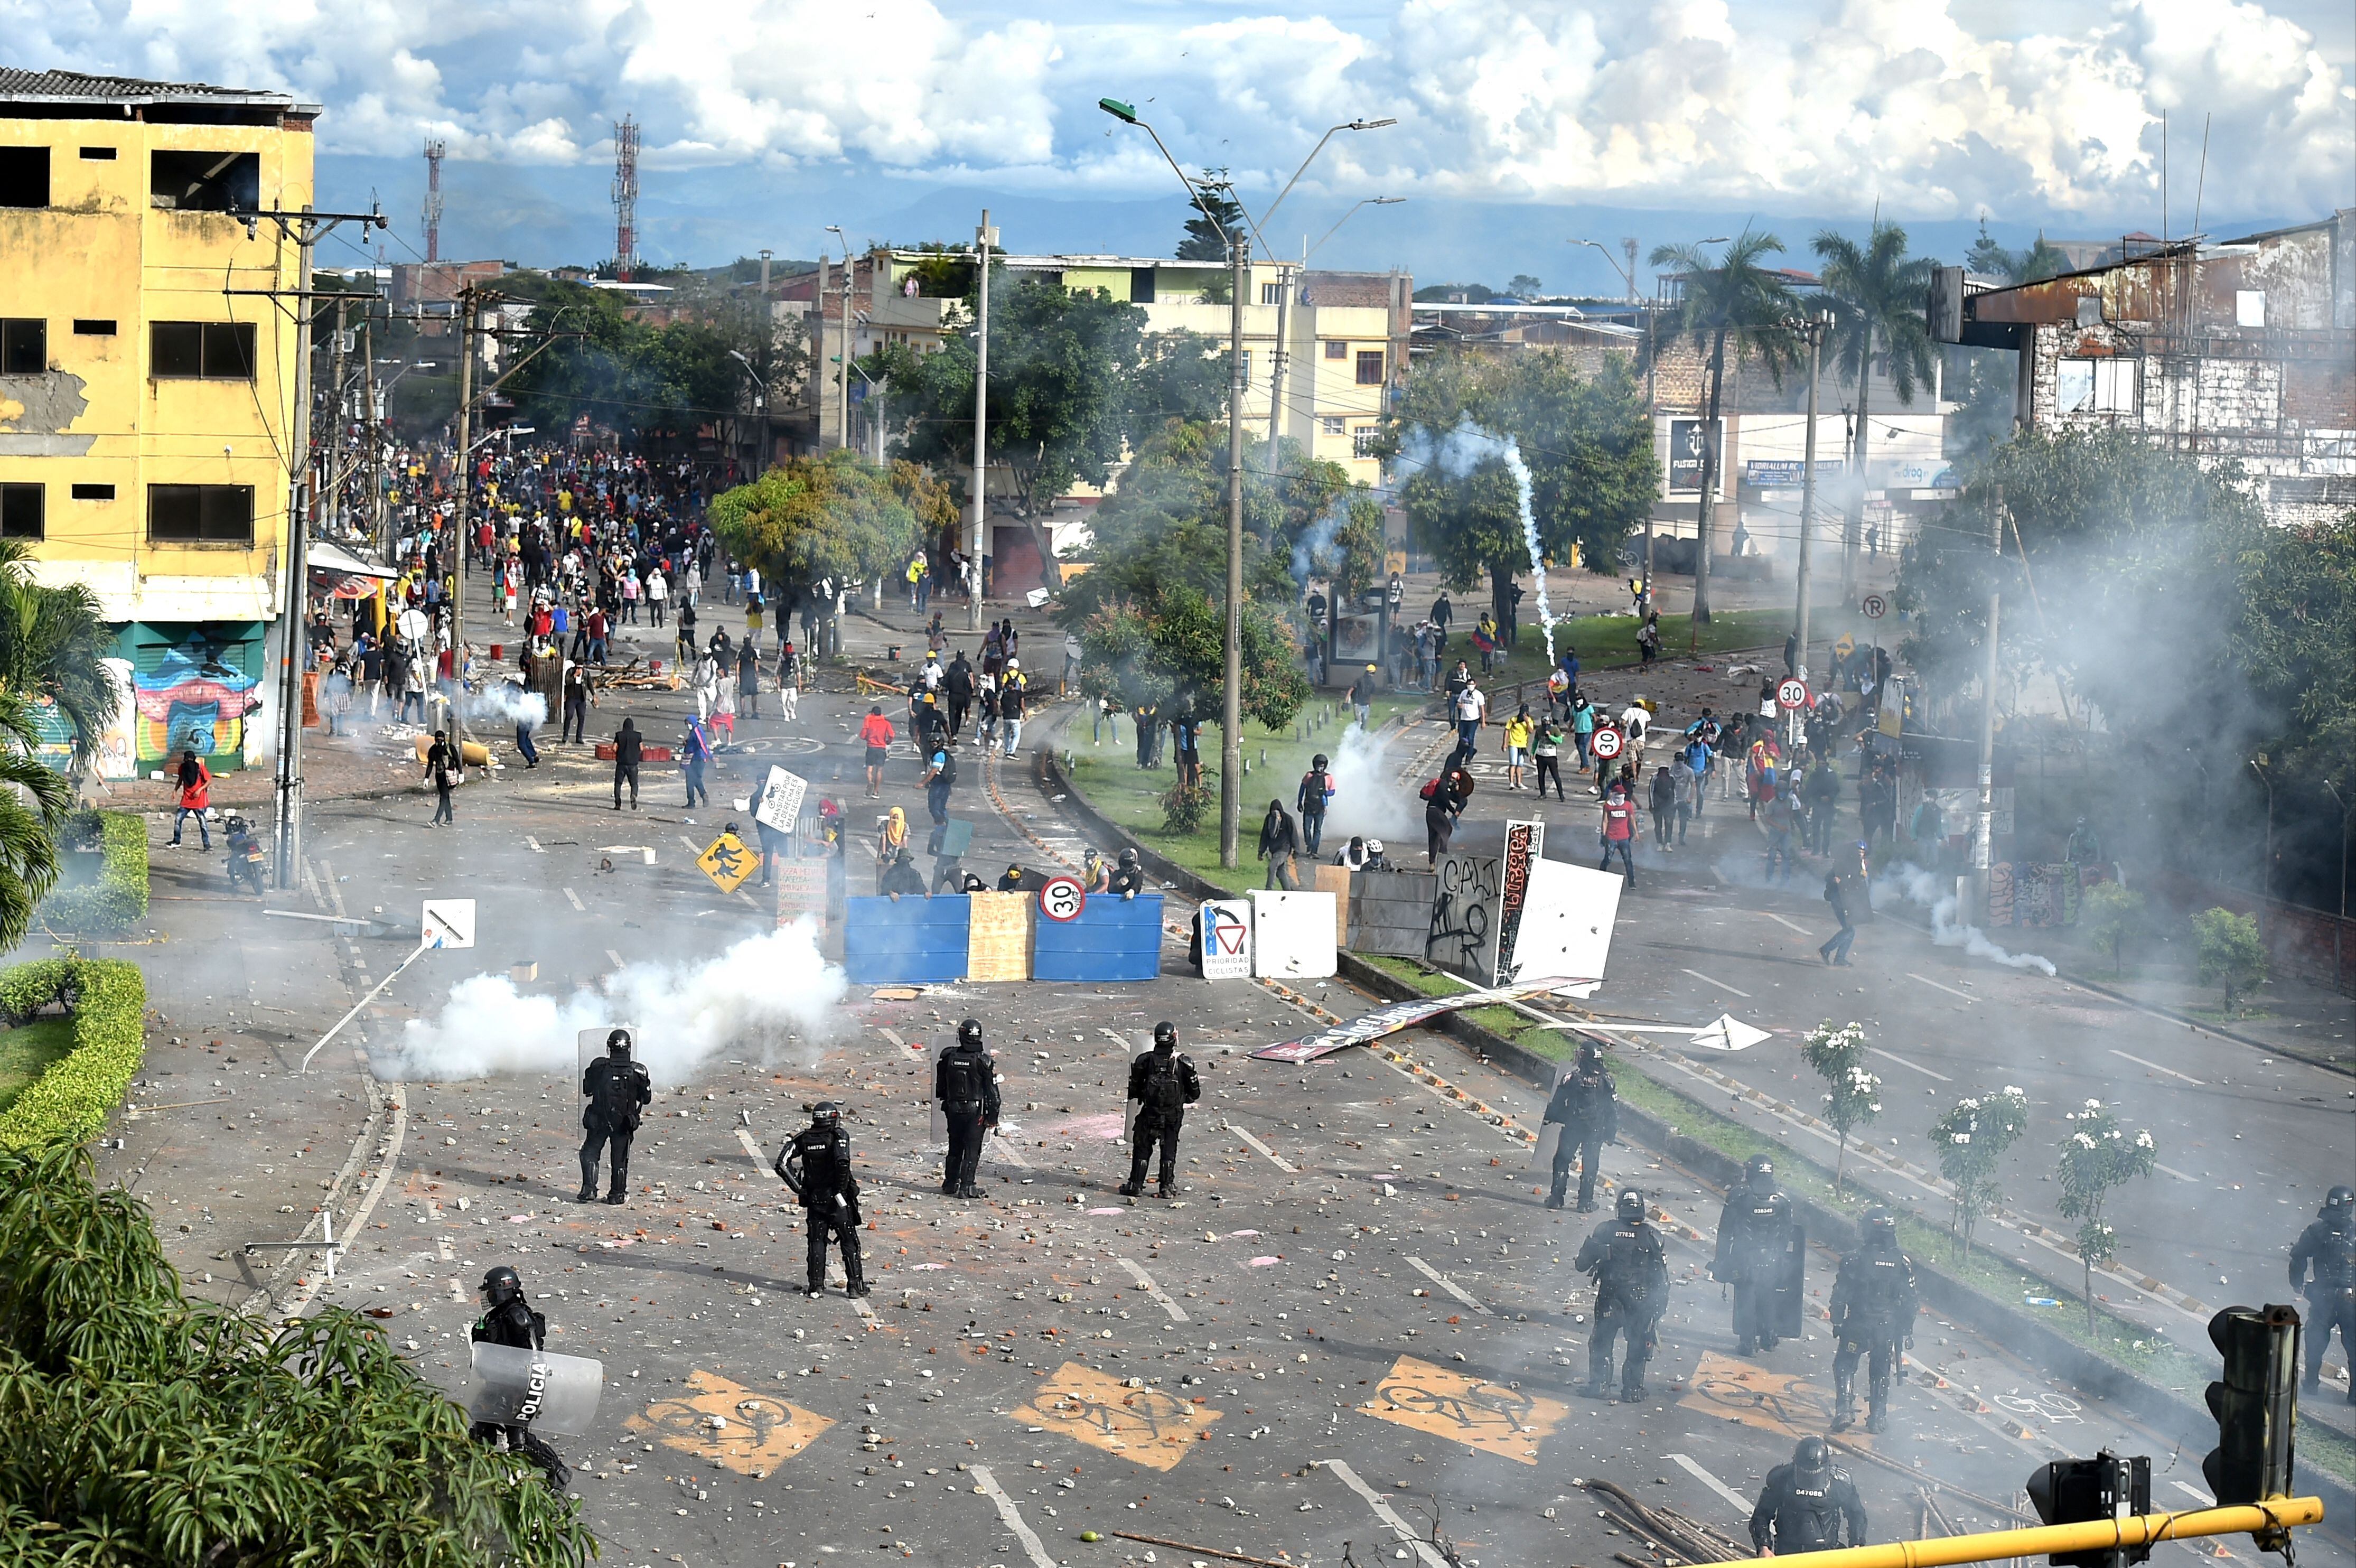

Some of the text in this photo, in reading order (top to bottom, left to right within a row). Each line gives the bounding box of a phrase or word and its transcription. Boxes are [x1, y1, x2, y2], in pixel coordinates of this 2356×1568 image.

[1751, 462, 1788, 470] VIDRIALUM
[1871, 600, 1881, 614] P
[1782, 687, 1802, 701] 30
[1600, 733, 1614, 752] 30
[771, 775, 791, 824] TRANSITAR POR
[778, 778, 798, 828] LA DERECHA ES
[790, 786, 803, 813] SEGURO
[1444, 856, 1501, 901] CALI
[1052, 886, 1073, 913] 30
[515, 1363, 547, 1421] POLICIA
